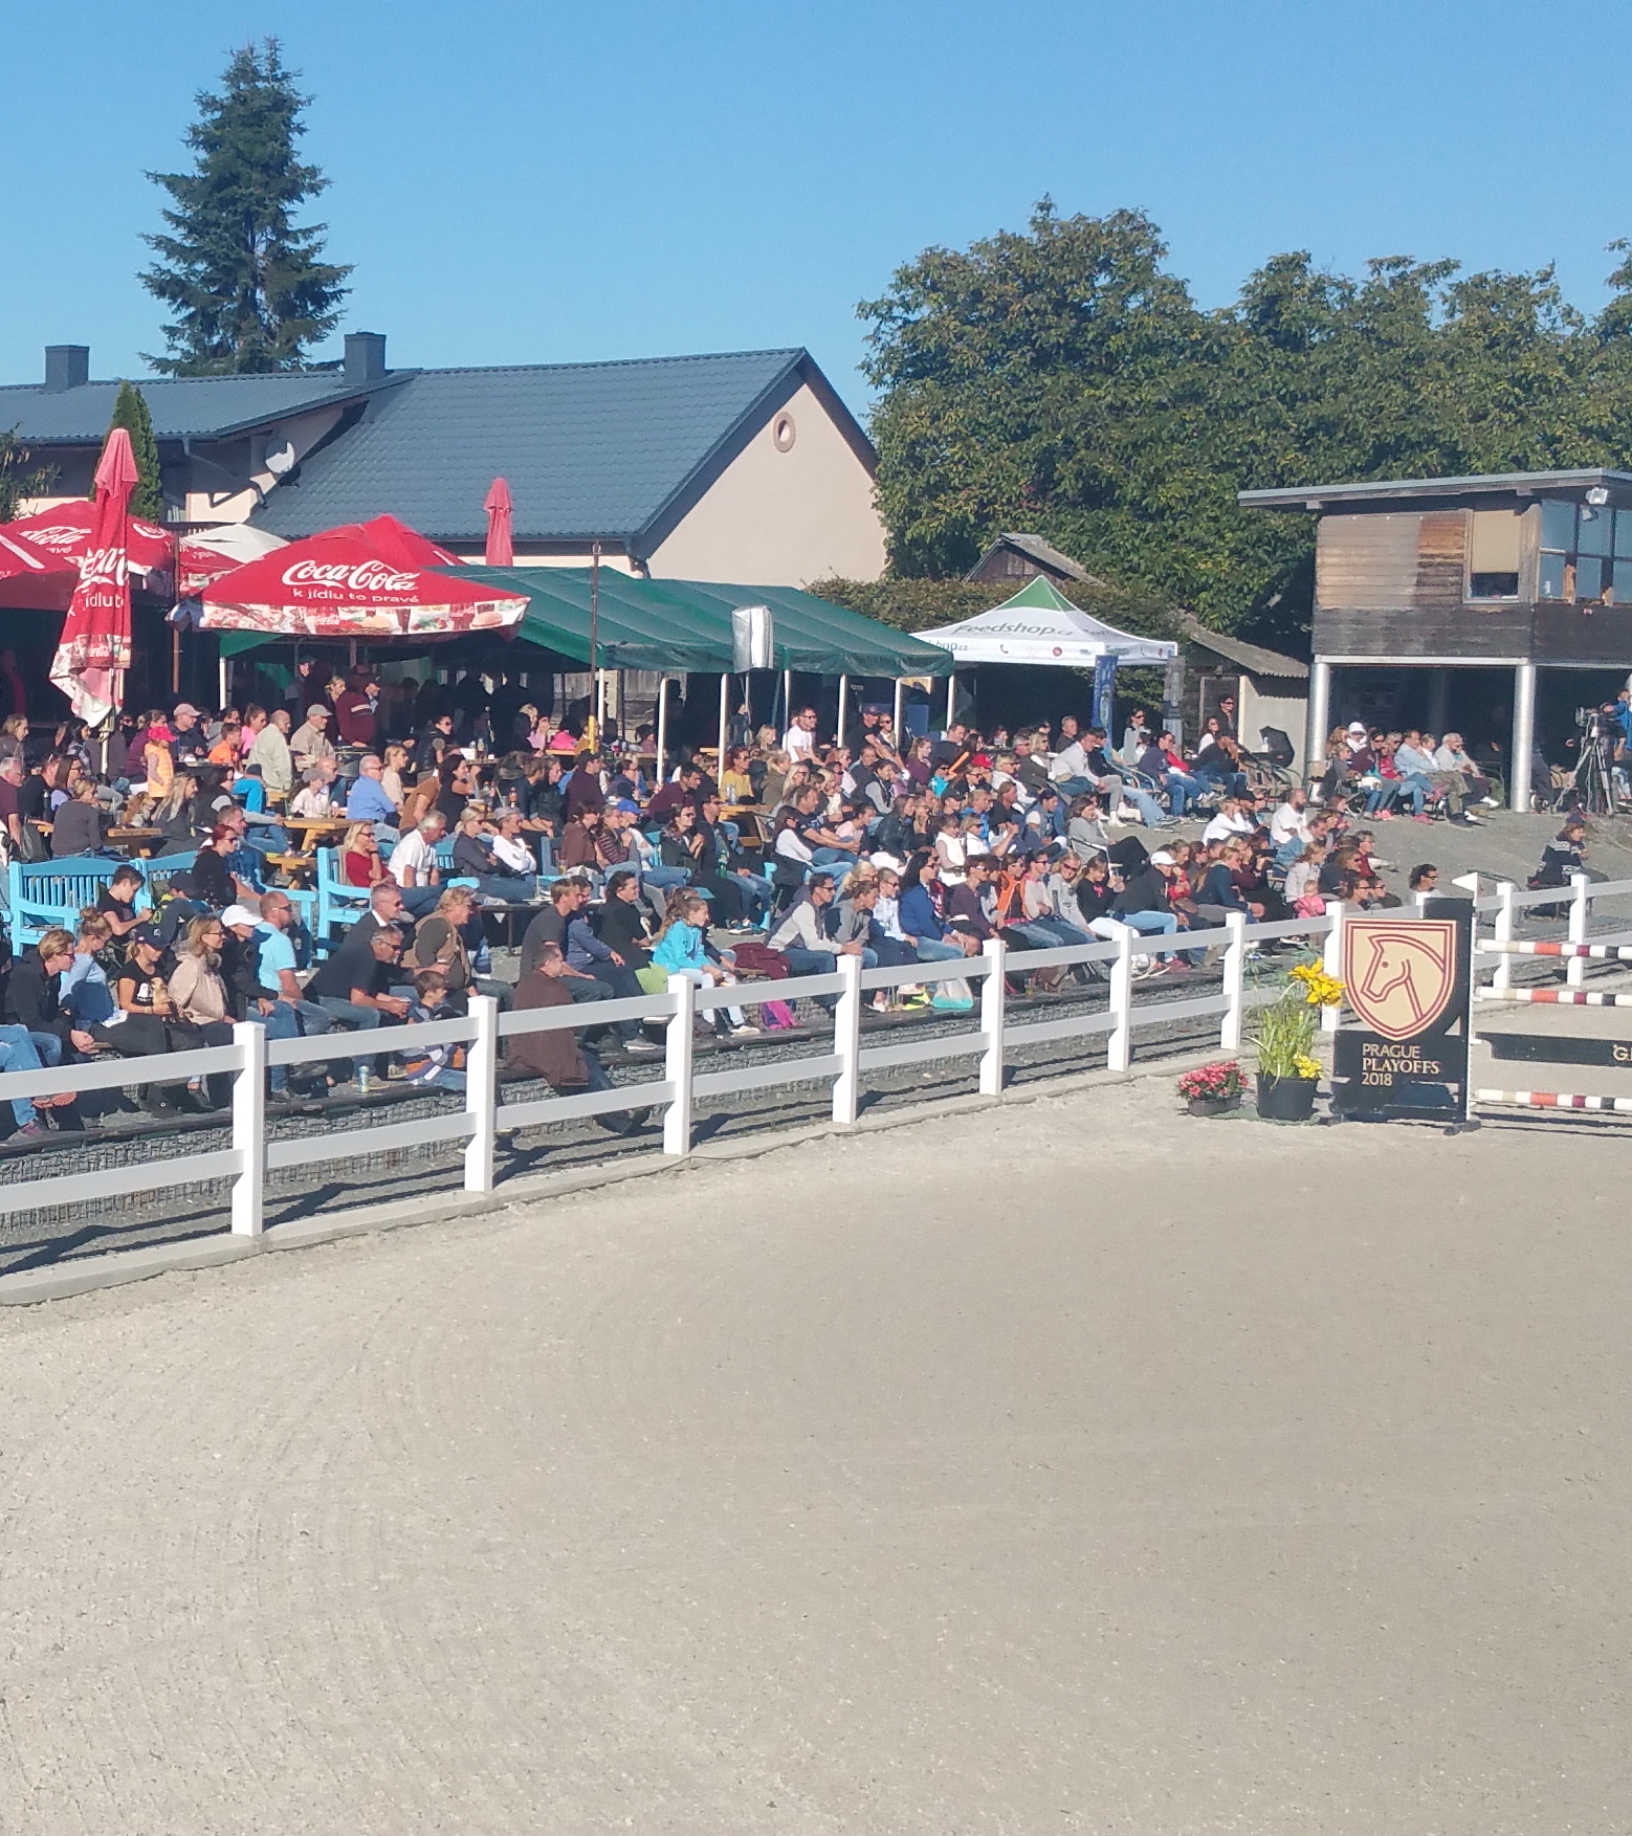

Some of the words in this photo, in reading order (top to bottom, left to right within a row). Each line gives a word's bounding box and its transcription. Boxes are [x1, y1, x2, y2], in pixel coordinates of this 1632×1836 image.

[282, 559, 421, 591] Coca-Cola
[293, 588, 303, 597] k
[308, 588, 344, 600] jídlu
[349, 593, 367, 601] to
[372, 594, 421, 603] pravé
[952, 622, 1074, 637] Feedshop.cz
[1362, 1042, 1421, 1059] PRAGUE
[1362, 1057, 1441, 1075] PLAYOFFS
[1361, 1072, 1393, 1086] 2018
